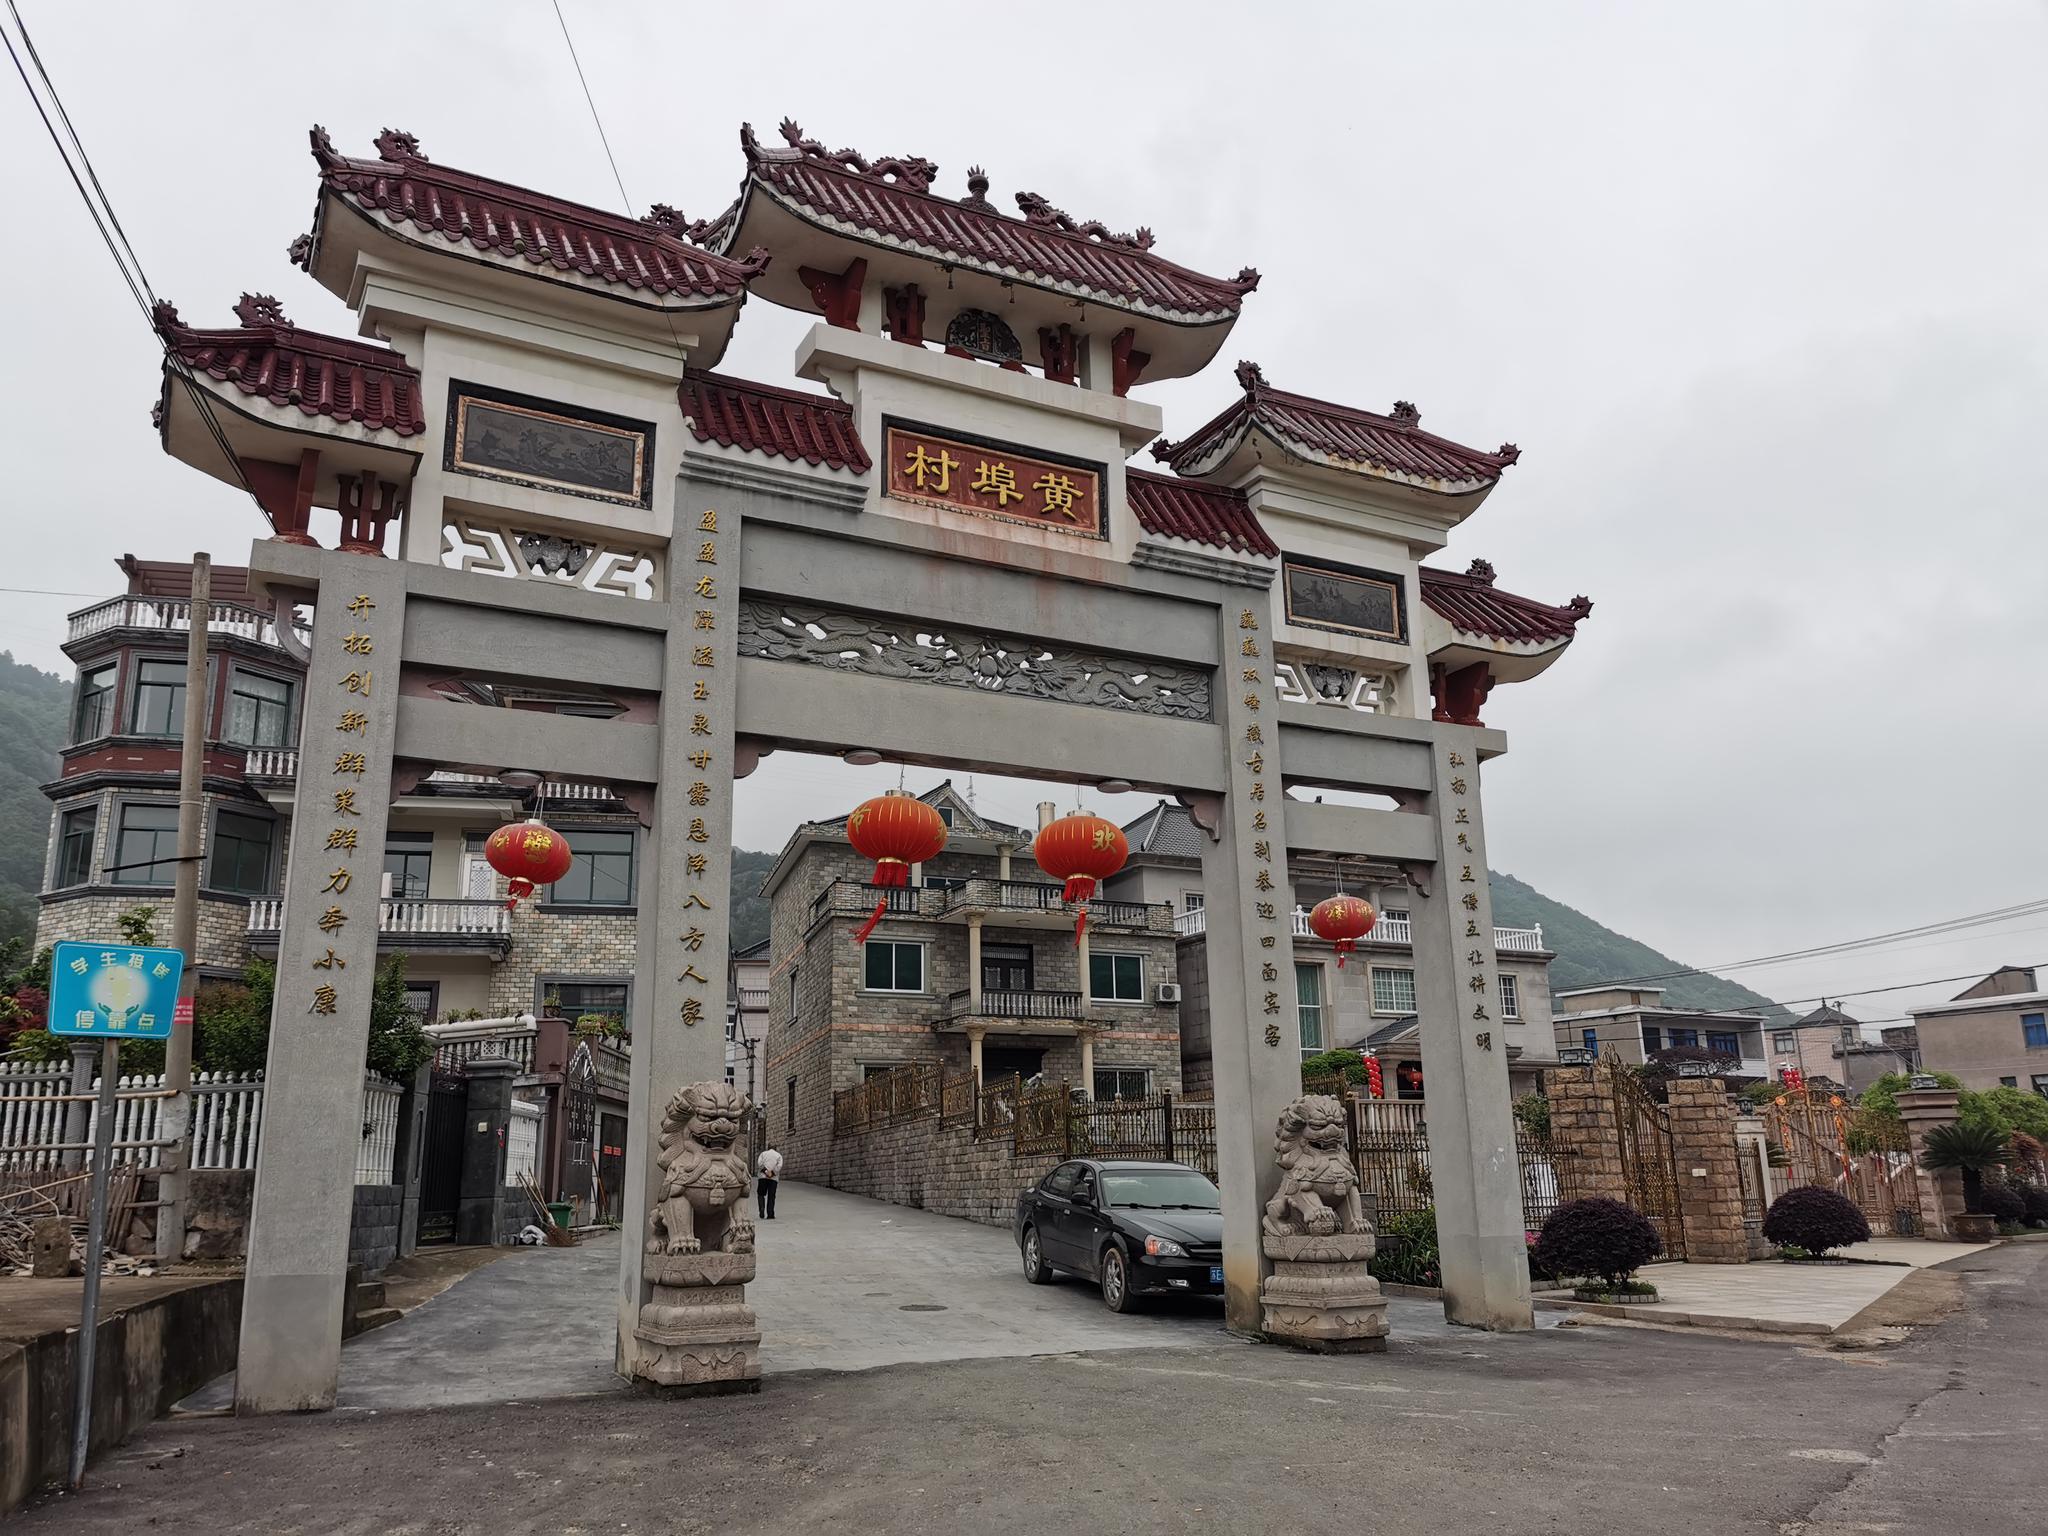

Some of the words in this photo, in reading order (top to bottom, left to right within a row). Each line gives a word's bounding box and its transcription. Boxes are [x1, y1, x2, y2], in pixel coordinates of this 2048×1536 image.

[903, 444, 1085, 522] 黄埠村
[307, 593, 377, 1017] 开拓创新群策群力奔小康
[75, 1009, 156, 1030] 停靠点
